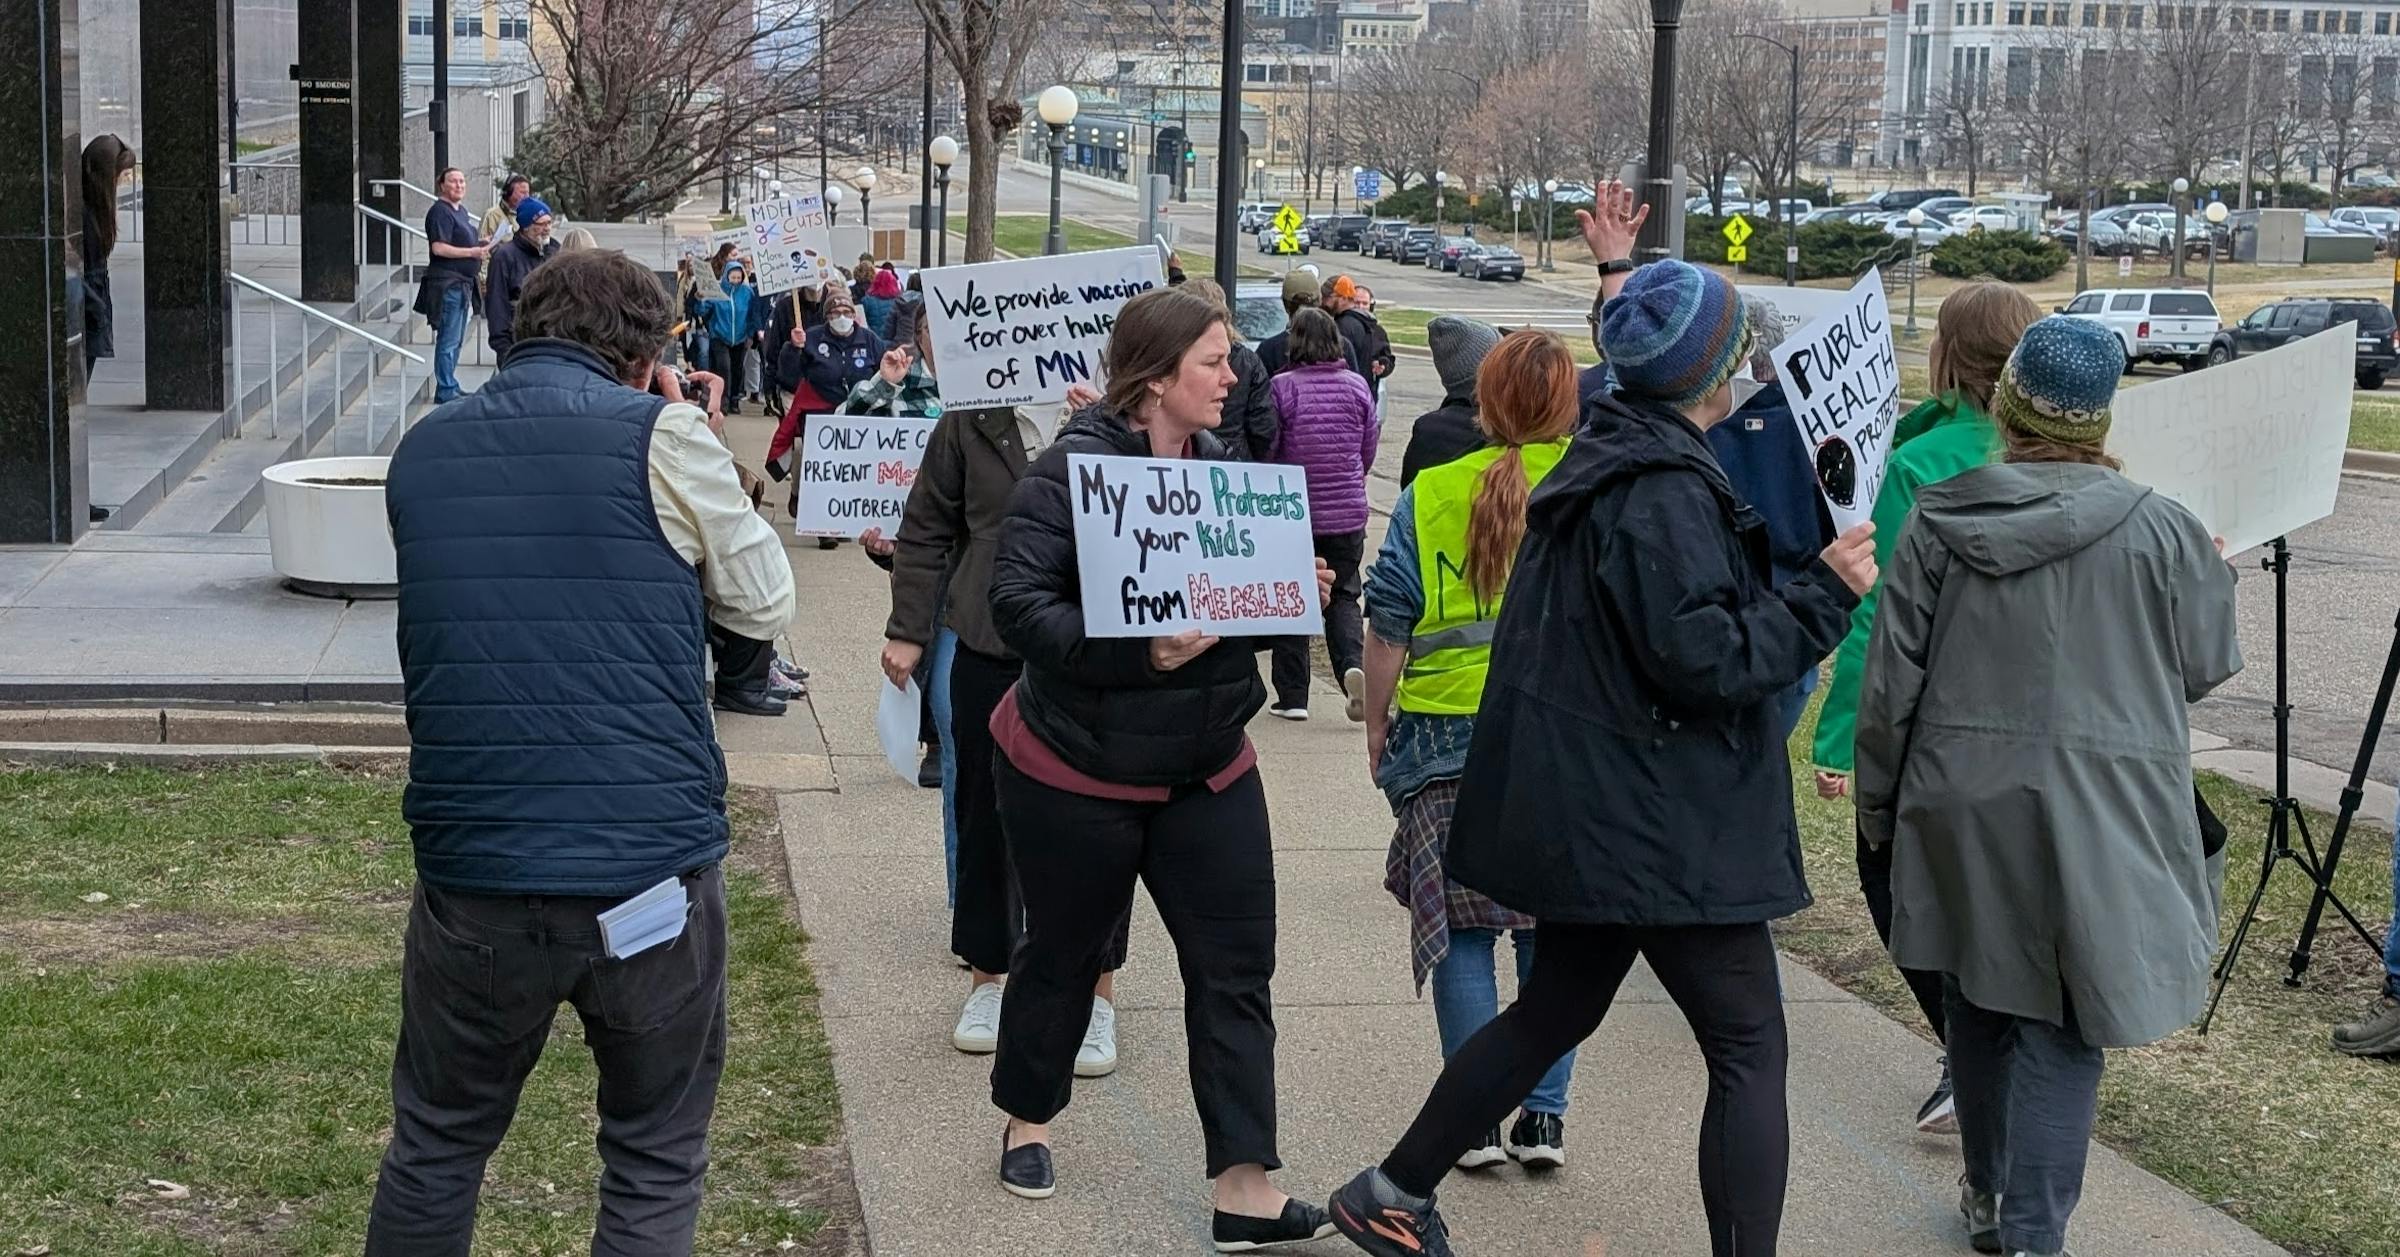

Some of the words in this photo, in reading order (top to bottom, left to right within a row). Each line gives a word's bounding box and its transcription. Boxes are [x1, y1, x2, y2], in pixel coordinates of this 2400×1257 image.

[315, 81, 351, 89] SMOKING
[752, 199, 792, 222] MDH
[783, 212, 823, 234] CUTS
[757, 249, 783, 263] More
[933, 279, 992, 321] We
[995, 282, 1074, 323] provide
[964, 321, 1008, 352] for
[1011, 320, 1060, 345] over
[1063, 312, 1116, 340] half
[1785, 292, 1882, 401] PUBLIC
[985, 357, 1020, 390] of
[1034, 349, 1091, 389] MN
[1800, 333, 1896, 446] HEALTH
[818, 425, 869, 451] ONLY
[876, 427, 910, 450] WE
[804, 460, 872, 483] PREVENT
[1078, 462, 1129, 538] My
[1145, 465, 1201, 516] Job
[1209, 466, 1305, 521] Protects
[1132, 527, 1190, 574] your
[1187, 572, 1307, 621] MEASLES
